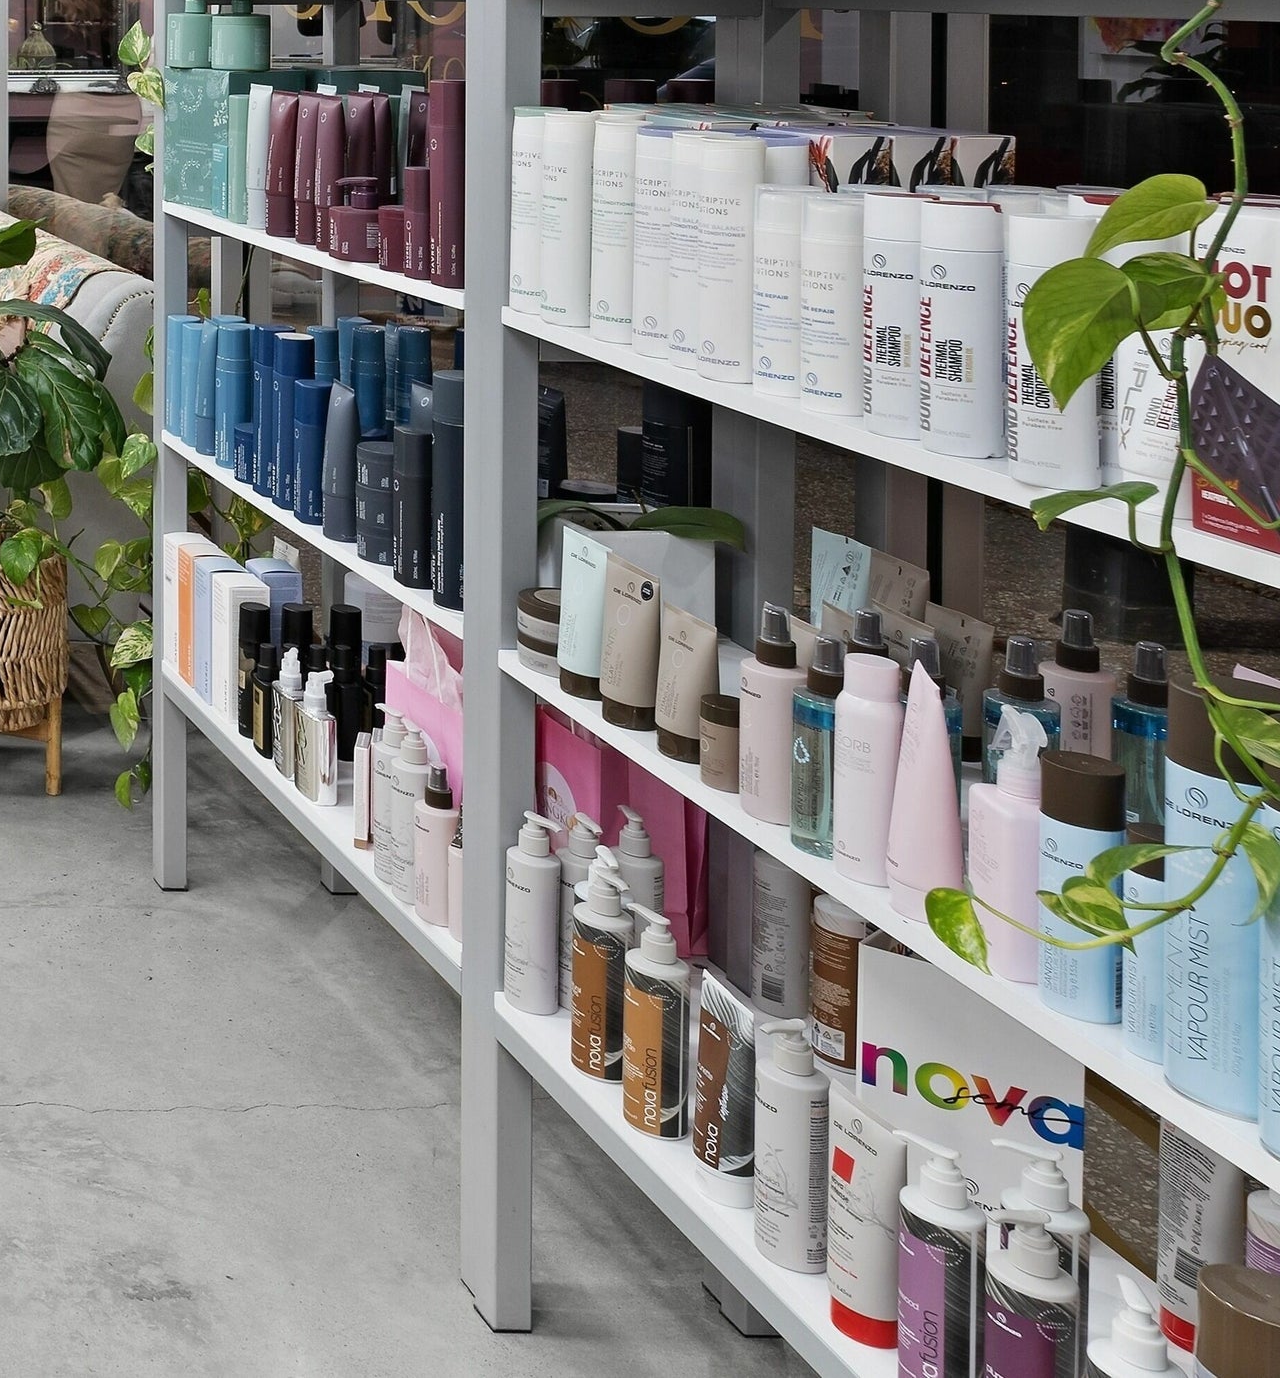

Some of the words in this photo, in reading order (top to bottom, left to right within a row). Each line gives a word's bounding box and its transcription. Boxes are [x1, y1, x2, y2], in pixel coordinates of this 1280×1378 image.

[867, 270, 914, 281] LORENZO
[925, 280, 976, 292] LORENZO
[876, 325, 888, 365] THERMAL
[887, 325, 902, 367] SHAMPOO
[919, 296, 932, 378] DEFENCE
[935, 339, 948, 380] THERMAL
[948, 339, 963, 383] SHAMPOO
[1007, 317, 1017, 404] DEFENCE
[1021, 363, 1034, 406] THERMAL
[1101, 356, 1114, 410] CONDITION
[919, 381, 932, 432] BOND
[1119, 366, 1148, 451] PLEX
[1144, 396, 1163, 426] BOND
[1007, 407, 1018, 461] BOND
[1176, 808, 1236, 831] LORENZ
[1044, 926, 1054, 992] SANDSTOM
[1188, 915, 1210, 970] MIST
[1127, 959, 1139, 990] MIST
[1187, 970, 1210, 1062] VAPOUR
[861, 1041, 1085, 1152] nova
[704, 1122, 720, 1164] nova
[833, 1119, 843, 1131] DE
[843, 1127, 878, 1158] LORENZO
